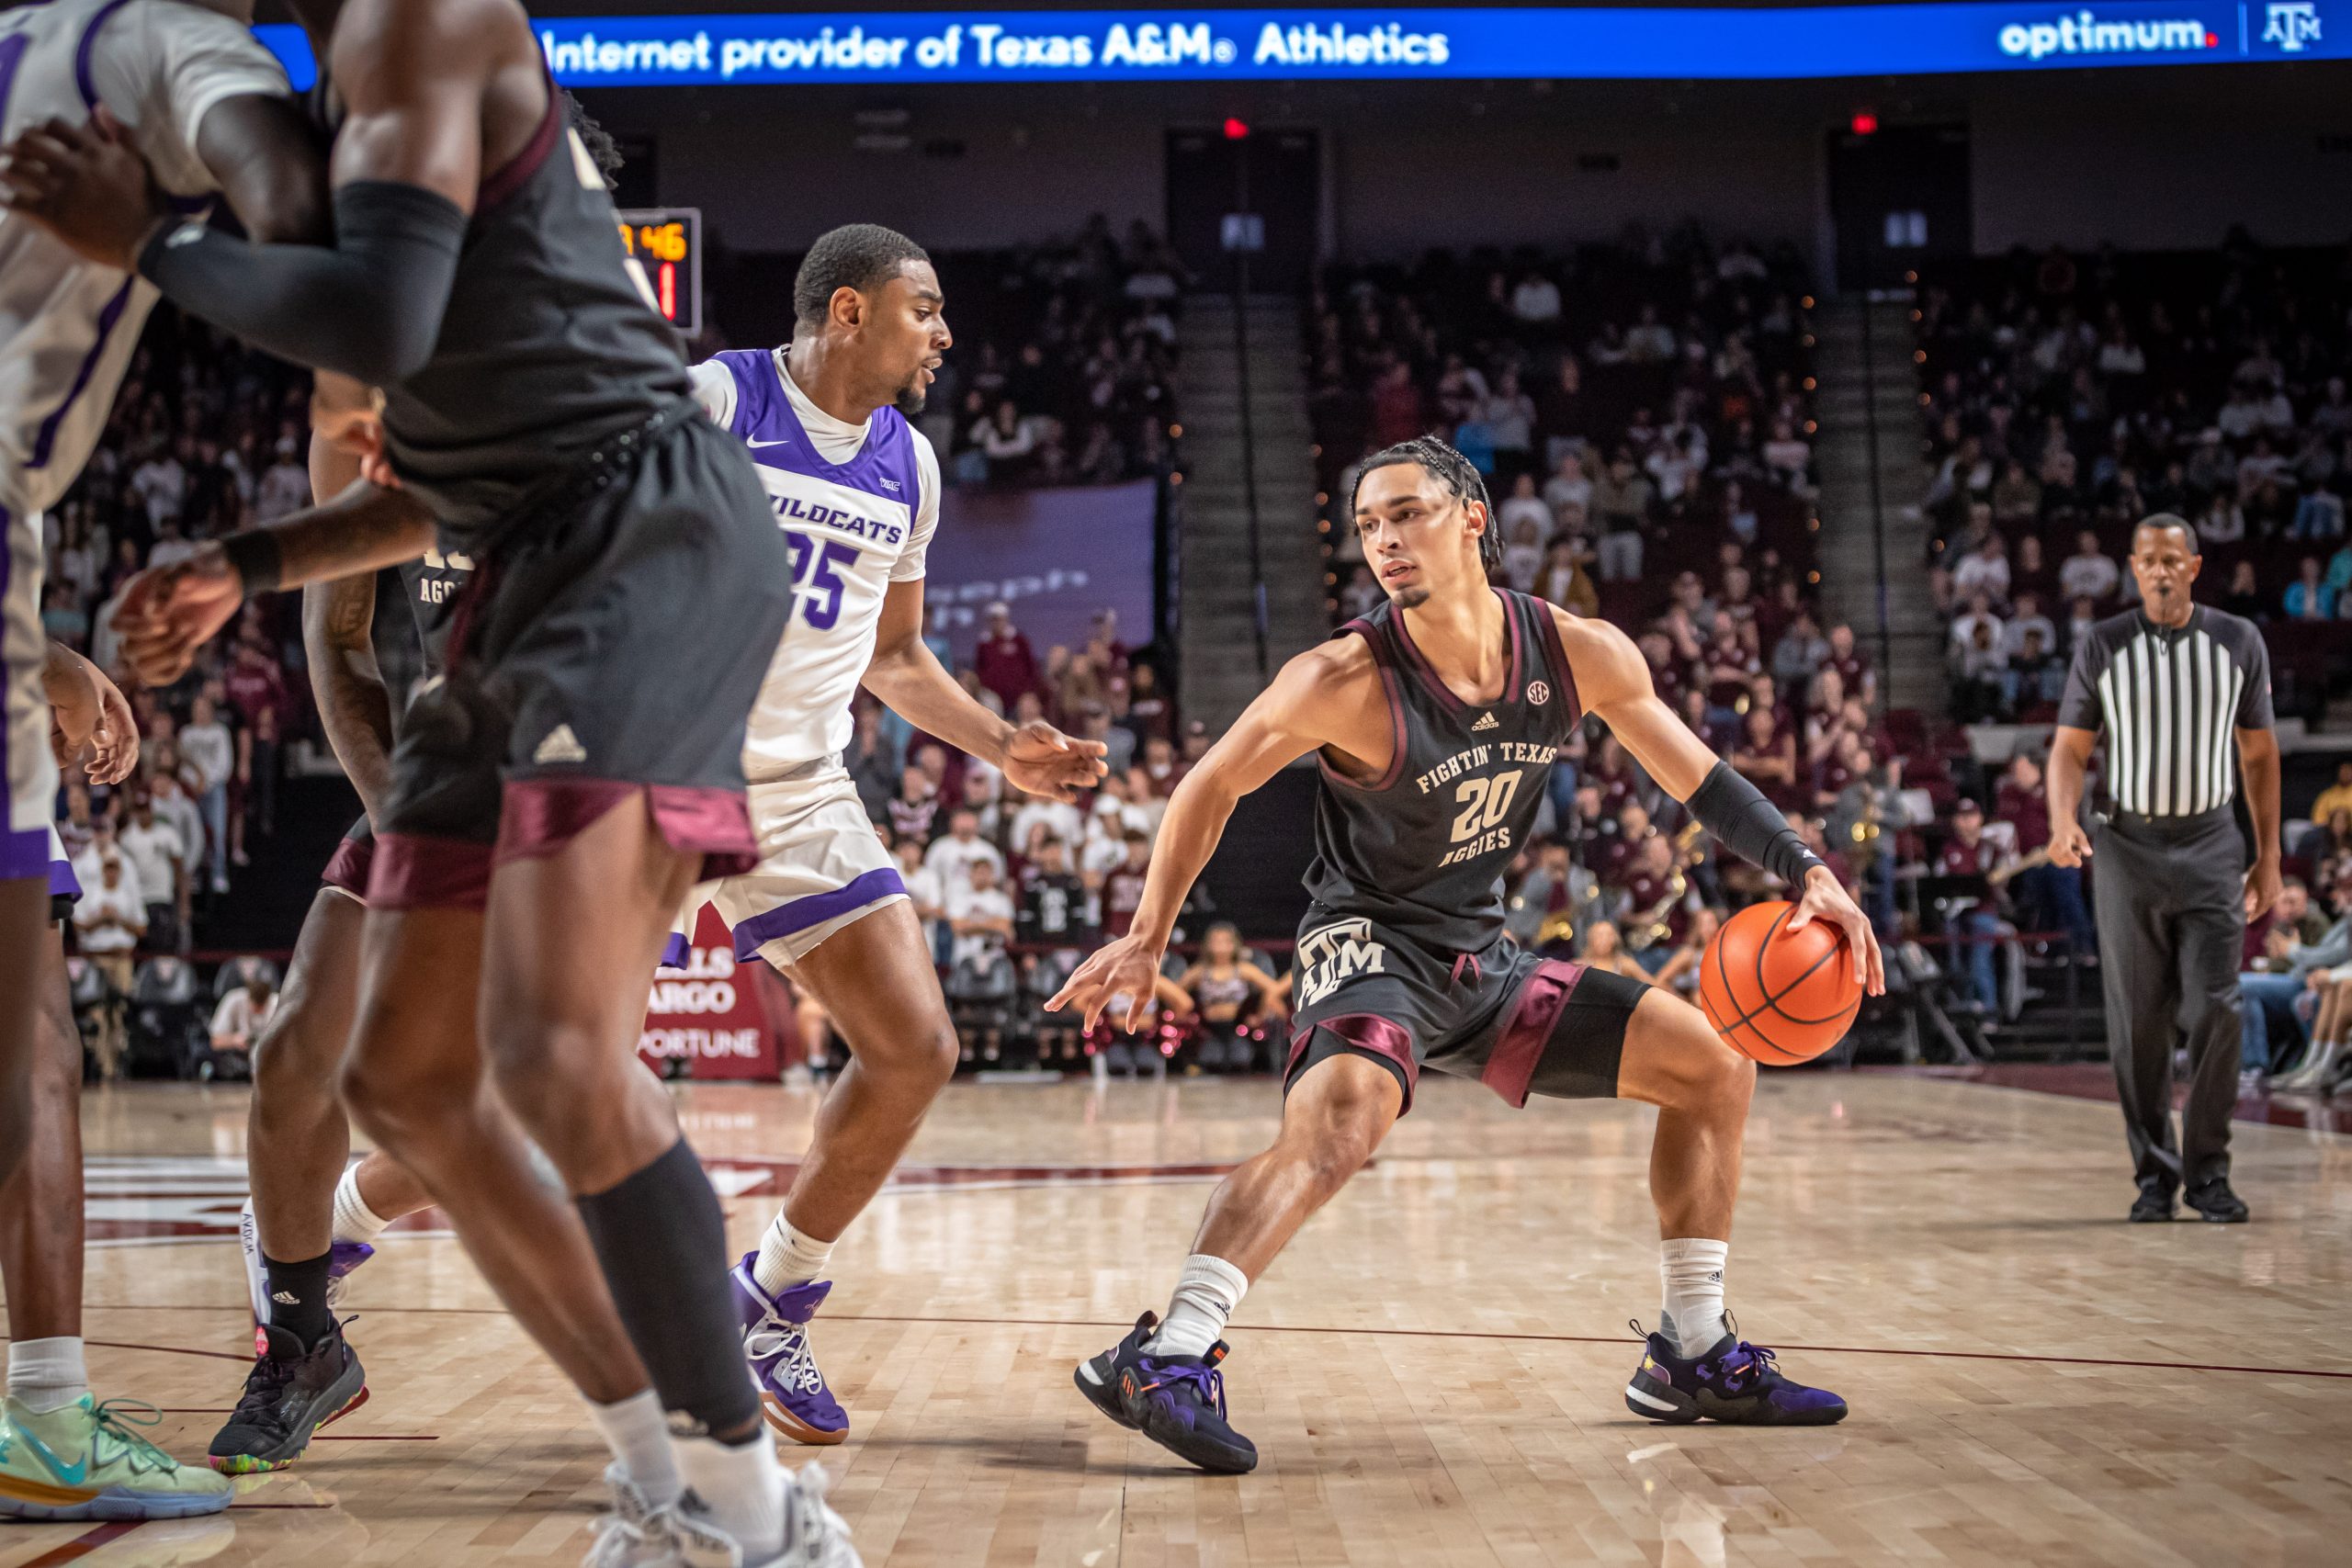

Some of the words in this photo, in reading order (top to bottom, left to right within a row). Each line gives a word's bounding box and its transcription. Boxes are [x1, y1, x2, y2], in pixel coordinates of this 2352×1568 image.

[720, 25, 908, 80] provider
[914, 25, 963, 70] of
[969, 24, 1094, 67] Texas
[1253, 22, 1451, 65] Athletics
[1528, 682, 1549, 704] SEC
[1471, 721, 1499, 731] adidas
[1499, 741, 1558, 764] TEXAS
[1450, 769, 1523, 843] 20
[1437, 827, 1511, 868] AGGIES
